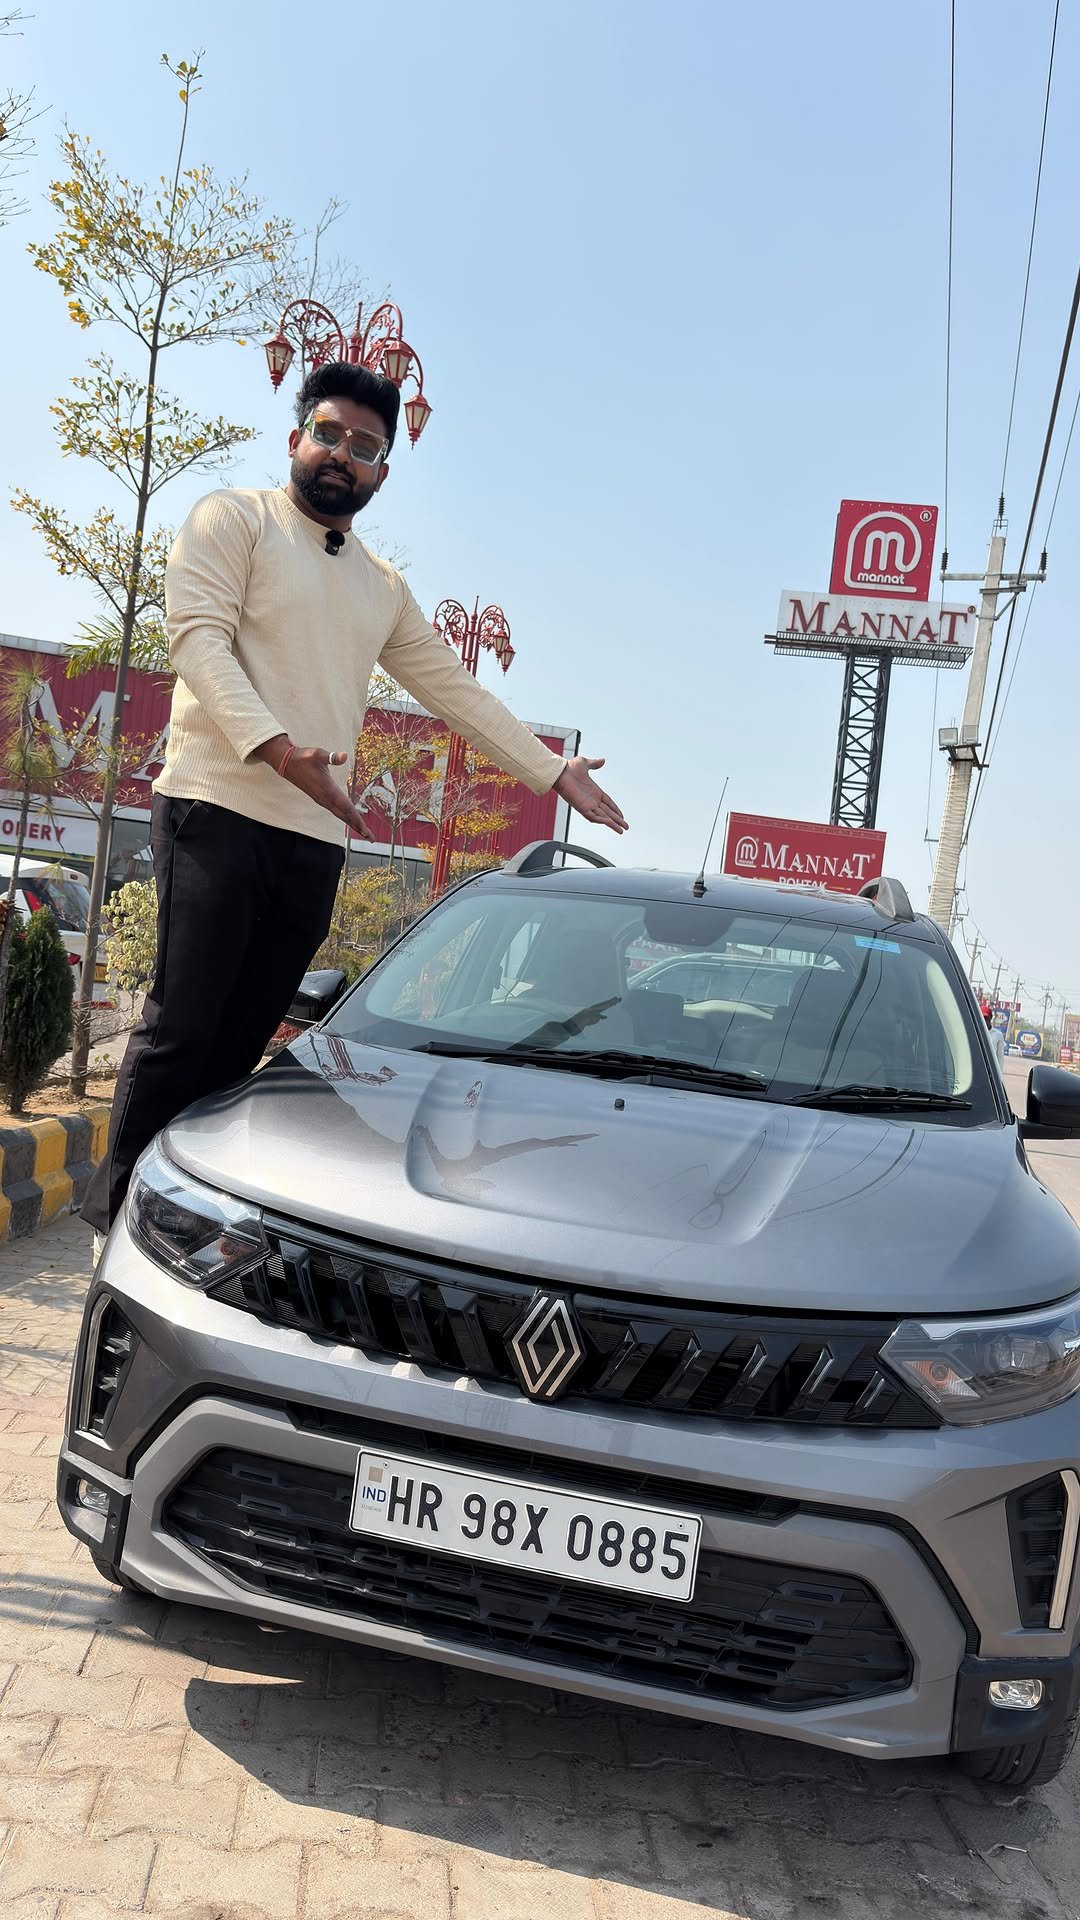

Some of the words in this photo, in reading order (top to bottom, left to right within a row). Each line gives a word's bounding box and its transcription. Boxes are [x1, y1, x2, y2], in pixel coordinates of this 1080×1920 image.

[857, 571, 905, 585] mannat
[786, 599, 968, 645] MANNAT
[761, 842, 871, 880] MANNAT
[362, 1486, 387, 1503] IND
[387, 1475, 443, 1532] HR
[460, 1493, 549, 1554] 98X
[566, 1514, 690, 1580] 0885
